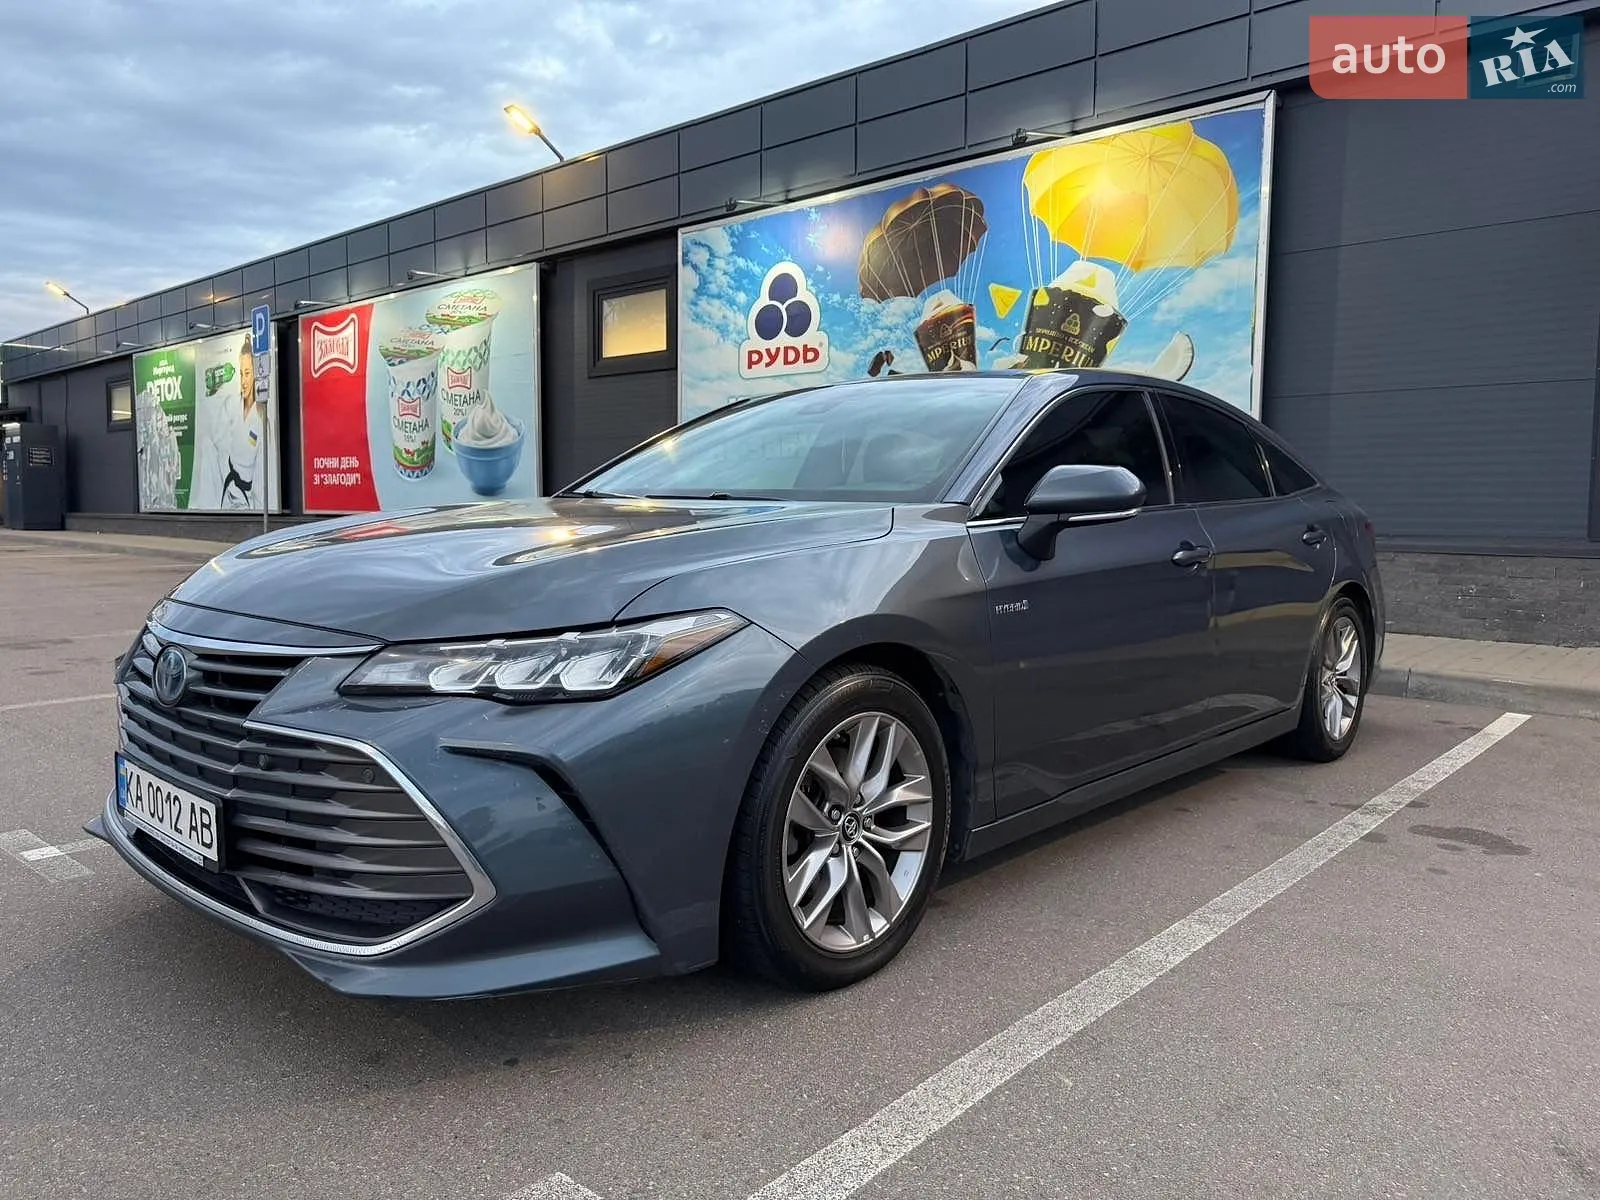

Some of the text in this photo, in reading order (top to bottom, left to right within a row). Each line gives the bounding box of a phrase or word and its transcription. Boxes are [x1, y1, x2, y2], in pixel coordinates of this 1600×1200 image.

[393, 415, 430, 434] СМЕТАНА
[313, 455, 360, 470] ПОЧНИ ДЕНЬ
[313, 473, 320, 485] ЗІ
[125, 767, 145, 814] KA
[147, 781, 183, 836] 0012
[188, 801, 214, 850] AB
